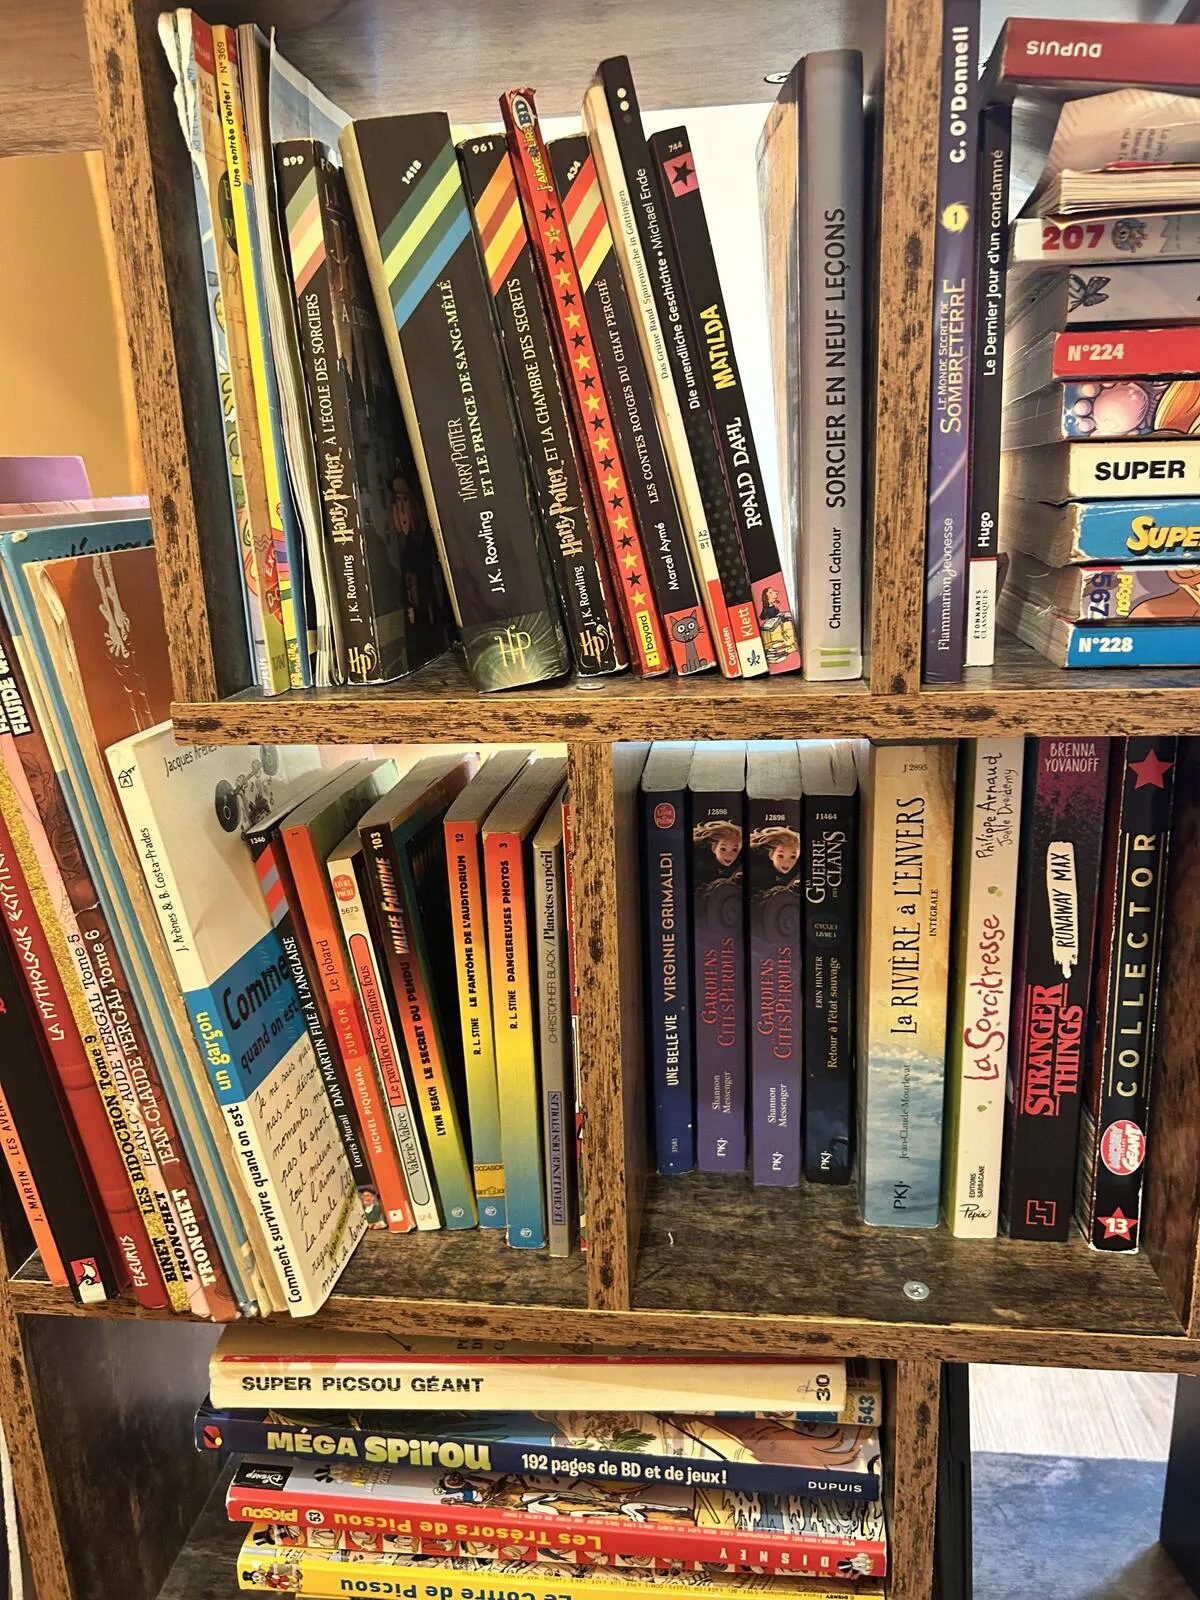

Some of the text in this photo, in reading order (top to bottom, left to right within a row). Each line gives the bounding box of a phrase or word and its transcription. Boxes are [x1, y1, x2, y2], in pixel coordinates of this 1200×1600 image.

[217, 40, 229, 74] N°369
[1026, 40, 1103, 58] DUPUIS
[950, 26, 969, 163] C. O'Donnell
[224, 88, 243, 188] Une rentrée d'enfer
[283, 156, 305, 167] 899
[472, 141, 494, 155] 961
[668, 141, 684, 152] 744
[402, 160, 423, 186] 1418
[566, 160, 582, 181] 434
[1041, 223, 1106, 251] 207
[632, 247, 651, 305] Spurensuche
[984, 150, 1004, 376] Le Dernier d'un condamné
[636, 168, 701, 410] Die unendliche Geschichte Michael Ende
[305, 293, 336, 434] L'ÉCOLE DES SORCIERS
[507, 278, 550, 424] CHAMBRE DES SECRETS
[700, 303, 738, 390] MATILDA
[824, 208, 851, 509] SORCIER EN NEUF LEÇONS
[940, 278, 966, 434] SOMBRETERRE
[1067, 343, 1125, 361] N°224
[437, 279, 495, 497] ET LE PRINCE DE SANG-MÊLÉ
[594, 278, 655, 481] CONTES ROUGES CHAT PERCHÉ
[938, 357, 947, 397] MONDE
[322, 447, 353, 501] Potter
[725, 416, 763, 530] ROALD DAHL
[1094, 460, 1186, 481] SUPER
[478, 510, 500, 566] Rowling
[978, 511, 994, 548] Hugo
[344, 554, 358, 600] Rowling
[653, 522, 680, 591] Marcel Aymé
[828, 527, 842, 629] Chantal Cahour
[938, 577, 951, 651] Flammarion
[1090, 573, 1113, 619] 567
[642, 615, 654, 651] bayard
[741, 606, 754, 638] Klett
[1079, 637, 1134, 653] N°228
[722, 627, 737, 667] Cornelsen
[1044, 757, 1100, 773] YOVANOFF
[1050, 742, 1096, 757] BRENNA
[975, 752, 1003, 860] Philippe Arnaud
[370, 831, 384, 850] 103
[455, 833, 464, 843] 12
[823, 831, 848, 888] CLANS
[139, 827, 185, 944] Arènes Costa-Prades
[806, 839, 826, 904] GUERRE
[340, 905, 360, 915] 5673
[500, 860, 516, 983] DANGEREUSES PHOTOS
[889, 797, 925, 1035] La RIVIÈRE L'ENVERS
[929, 888, 940, 937] INTÉGRALE
[1050, 852, 1076, 949] RUNAWAY MAX
[457, 855, 478, 1007] LE FANTÔME L'AUDITORIUM
[660, 852, 677, 1002] VIRGINIE GRIMALDI
[14, 926, 65, 1041] LA MYTHOLOGIE
[543, 891, 558, 1043] CHRISTOPHER Planètes
[701, 949, 718, 1024] GARDIENS
[1116, 833, 1158, 1098] COLLECTOR
[401, 962, 434, 1080] LE SECRET PENDU
[756, 958, 775, 1036] GARDIENS
[282, 936, 345, 1108] DAN MARTIN FILE L'ANGLAISE
[93, 942, 181, 1166] JEAN-CLAUDE TERGAL Tome
[196, 1011, 232, 1092] un garçon
[377, 1042, 398, 1087] pavillon
[665, 1014, 680, 1086] UNE BELLE VIE
[827, 1034, 838, 1068] Retour
[963, 1054, 999, 1081] La
[1024, 982, 1066, 1117] STRANGER
[1054, 1004, 1085, 1096] THINGS
[354, 1065, 383, 1154] MICHEL PIQUEMAL
[427, 1086, 446, 1137] LYNN BEACH
[712, 1074, 721, 1110] Shannon
[722, 1071, 733, 1114] Messenger
[768, 1087, 776, 1124] Shannon
[778, 1083, 790, 1127] Messenger
[104, 1093, 145, 1183] BIDOCHON
[18, 1170, 39, 1210] MARTIN
[227, 1105, 302, 1304] Comment quand on est
[977, 1165, 985, 1199] SARBACANE
[153, 1190, 194, 1283] TRONCHET
[171, 1188, 216, 1288] TRONCHET
[1105, 1217, 1129, 1234] 13
[119, 1235, 149, 1288] FLEURUS
[152, 1237, 178, 1284] BINET
[242, 1376, 312, 1393] SUPER
[410, 1373, 484, 1393] GÉANT
[815, 1374, 831, 1402] 30
[858, 1394, 876, 1425] 543
[266, 1428, 359, 1458] MÉGA
[521, 1453, 549, 1471] 192
[551, 1458, 595, 1477] pages
[598, 1460, 618, 1476] de
[621, 1461, 642, 1478] BD
[644, 1465, 662, 1480] et
[664, 1466, 684, 1482] de
[808, 1480, 863, 1494] DUPUIS
[334, 1512, 412, 1534] Picsou
[419, 1519, 449, 1536] de
[455, 1518, 552, 1548] Trésors
[558, 1533, 603, 1551] Les
[719, 1546, 831, 1569] DISNEY
[340, 1578, 418, 1599] Picsou
